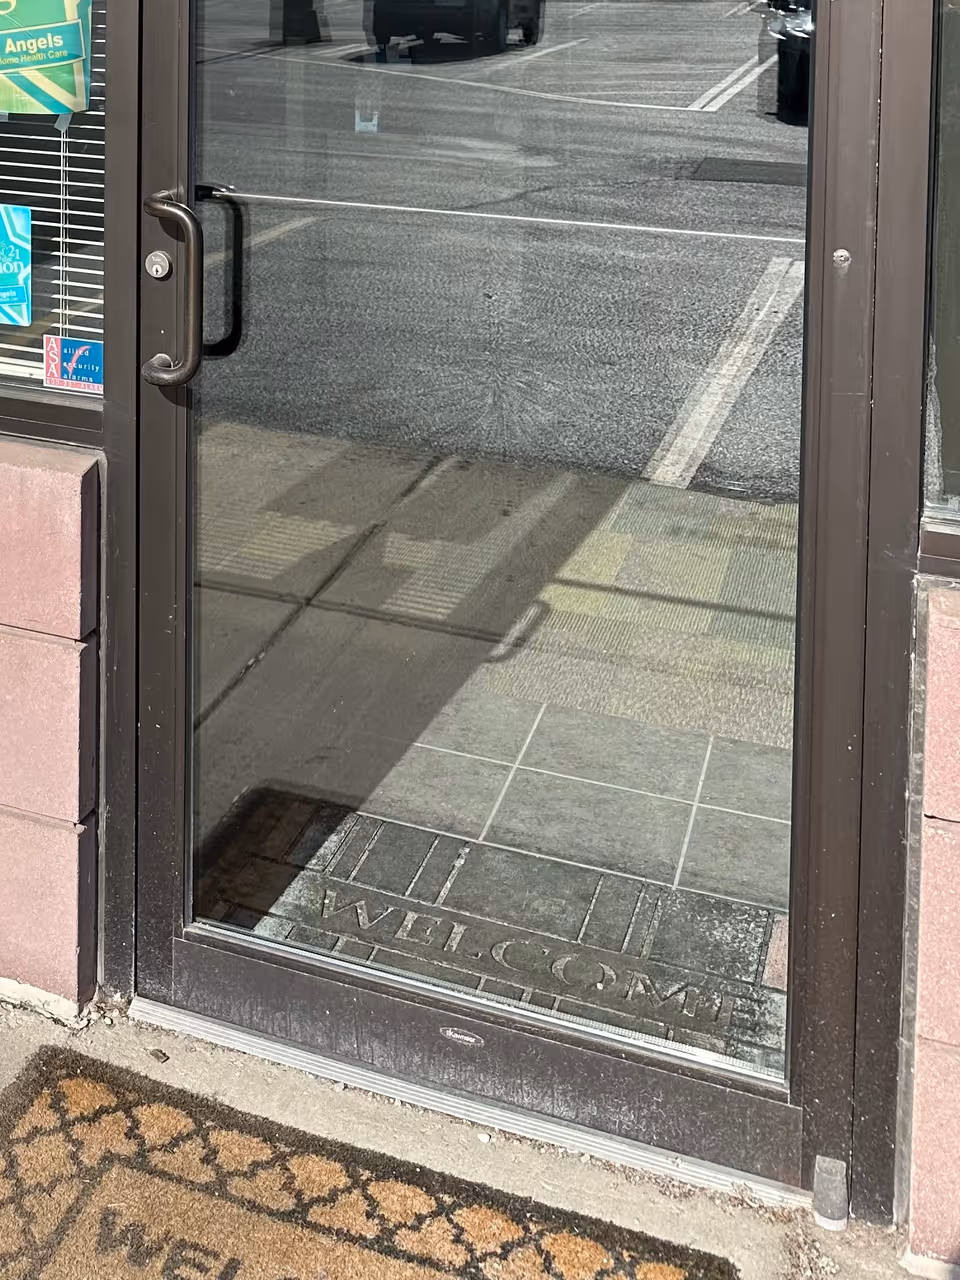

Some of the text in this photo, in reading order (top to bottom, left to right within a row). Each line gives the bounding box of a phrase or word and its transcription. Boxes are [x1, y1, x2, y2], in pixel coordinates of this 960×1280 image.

[4, 32, 65, 54] Angels
[19, 52, 47, 63] Health
[47, 49, 68, 60] Care
[46, 337, 59, 378] ASA
[63, 373, 94, 383] alarms
